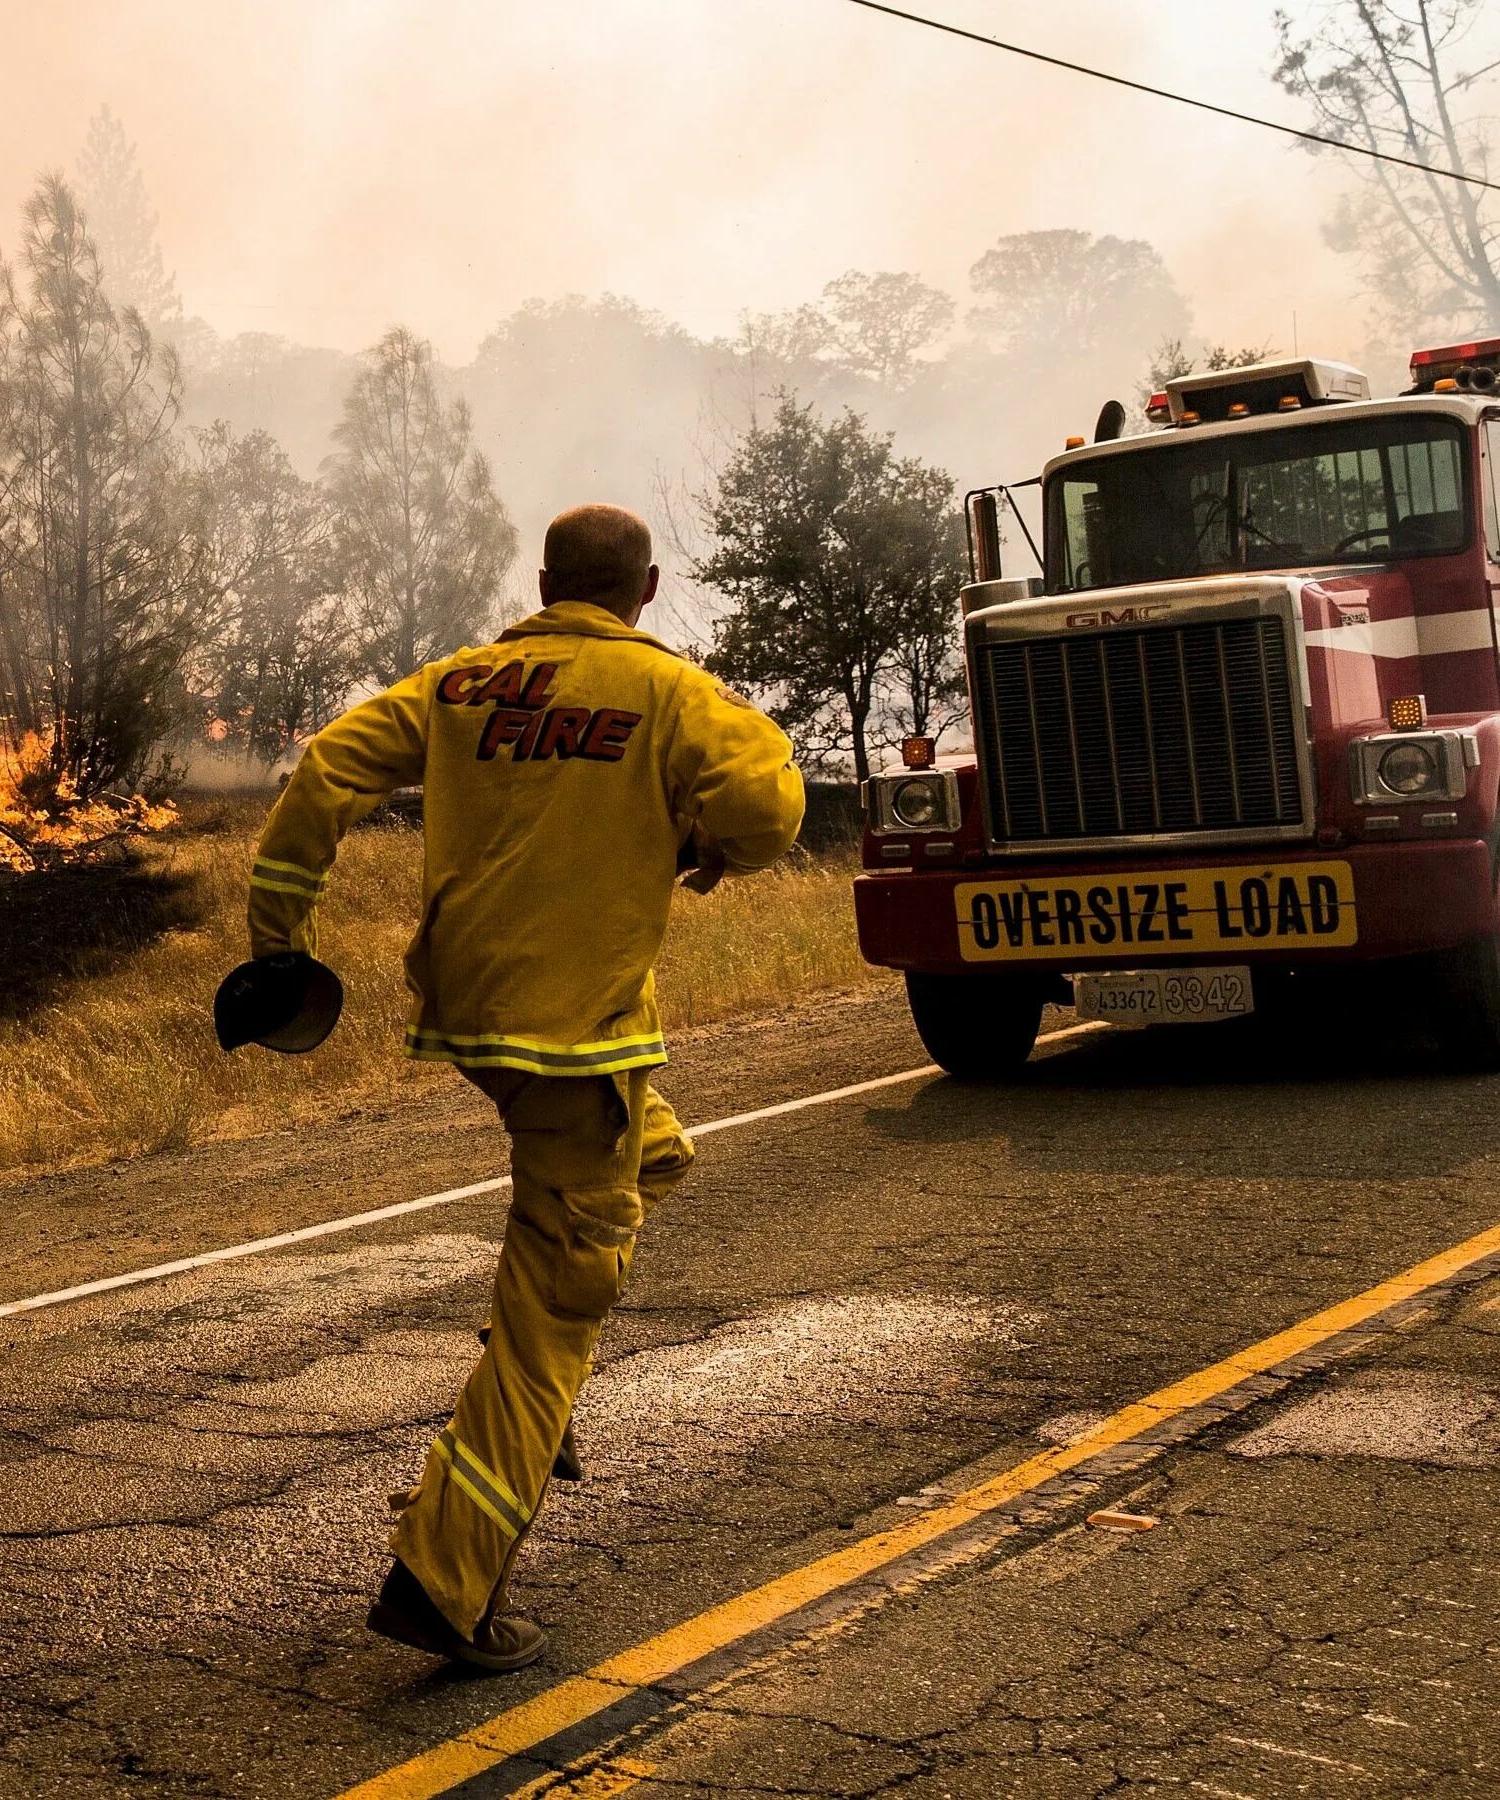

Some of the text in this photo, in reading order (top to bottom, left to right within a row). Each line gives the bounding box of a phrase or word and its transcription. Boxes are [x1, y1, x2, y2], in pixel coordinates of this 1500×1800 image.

[1067, 604, 1172, 628] GMC
[437, 661, 558, 710] CAL
[477, 707, 642, 762] FIRE
[971, 875, 1340, 949] OVERSIZE LOAD
[1165, 975, 1245, 1014] 3342
